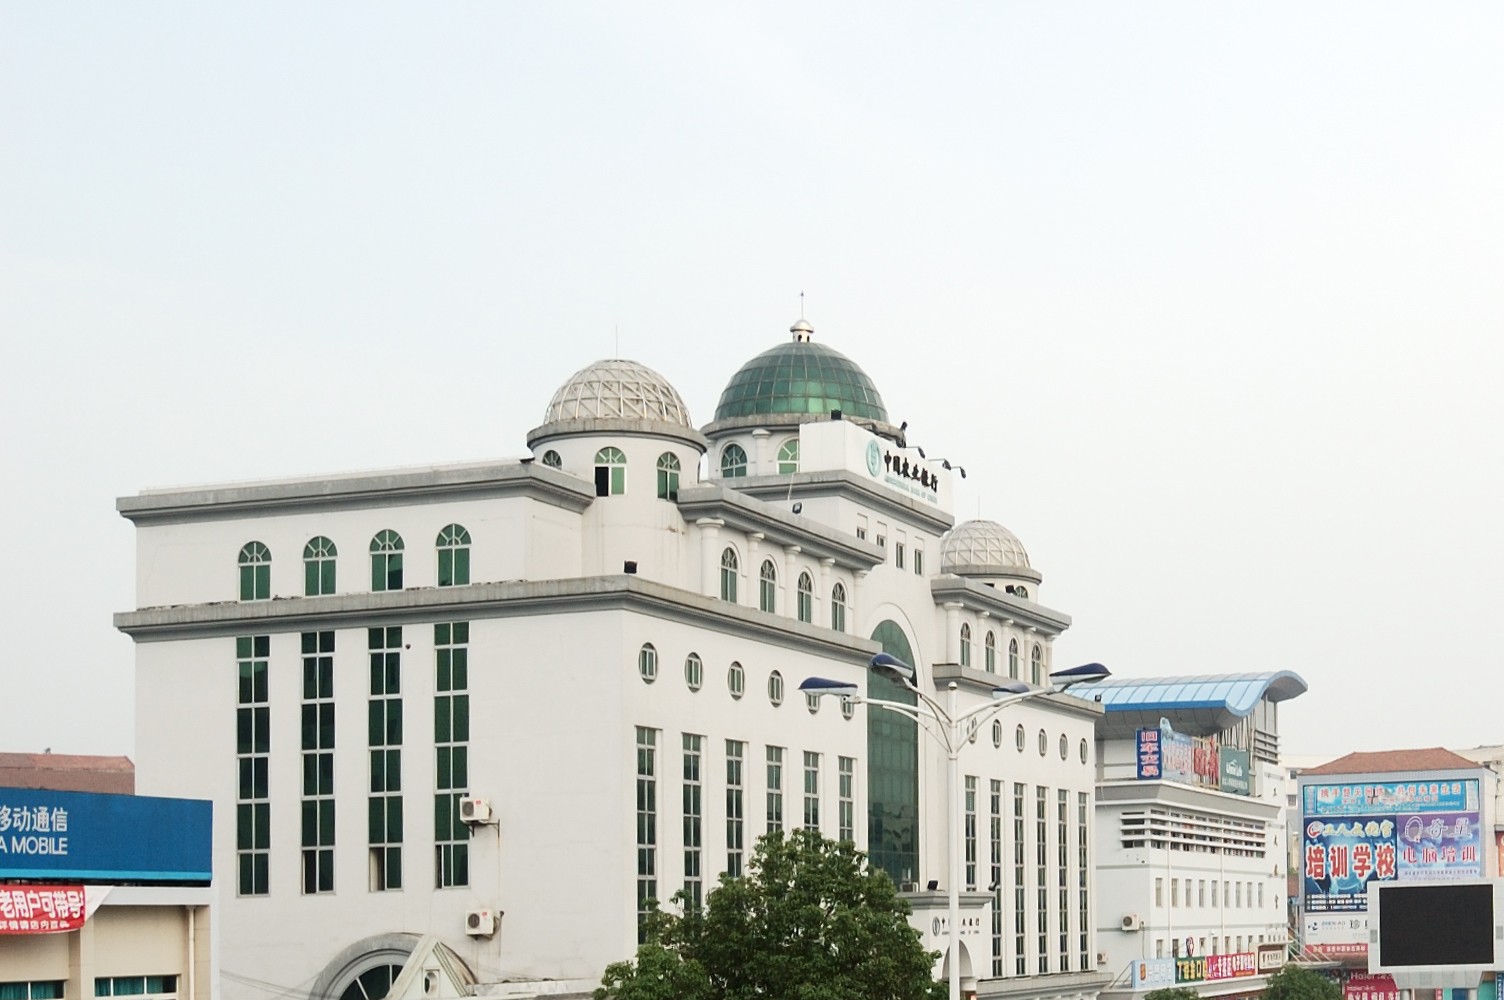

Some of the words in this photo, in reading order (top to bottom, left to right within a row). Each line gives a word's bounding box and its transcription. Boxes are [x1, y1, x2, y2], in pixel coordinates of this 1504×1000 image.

[0, 805, 68, 832] 移动通信
[12, 836, 68, 855] MOBILE
[1402, 846, 1477, 864] 电脑培训
[1305, 843, 1396, 880] 培训学校
[0, 890, 84, 918] 老用户可带号
